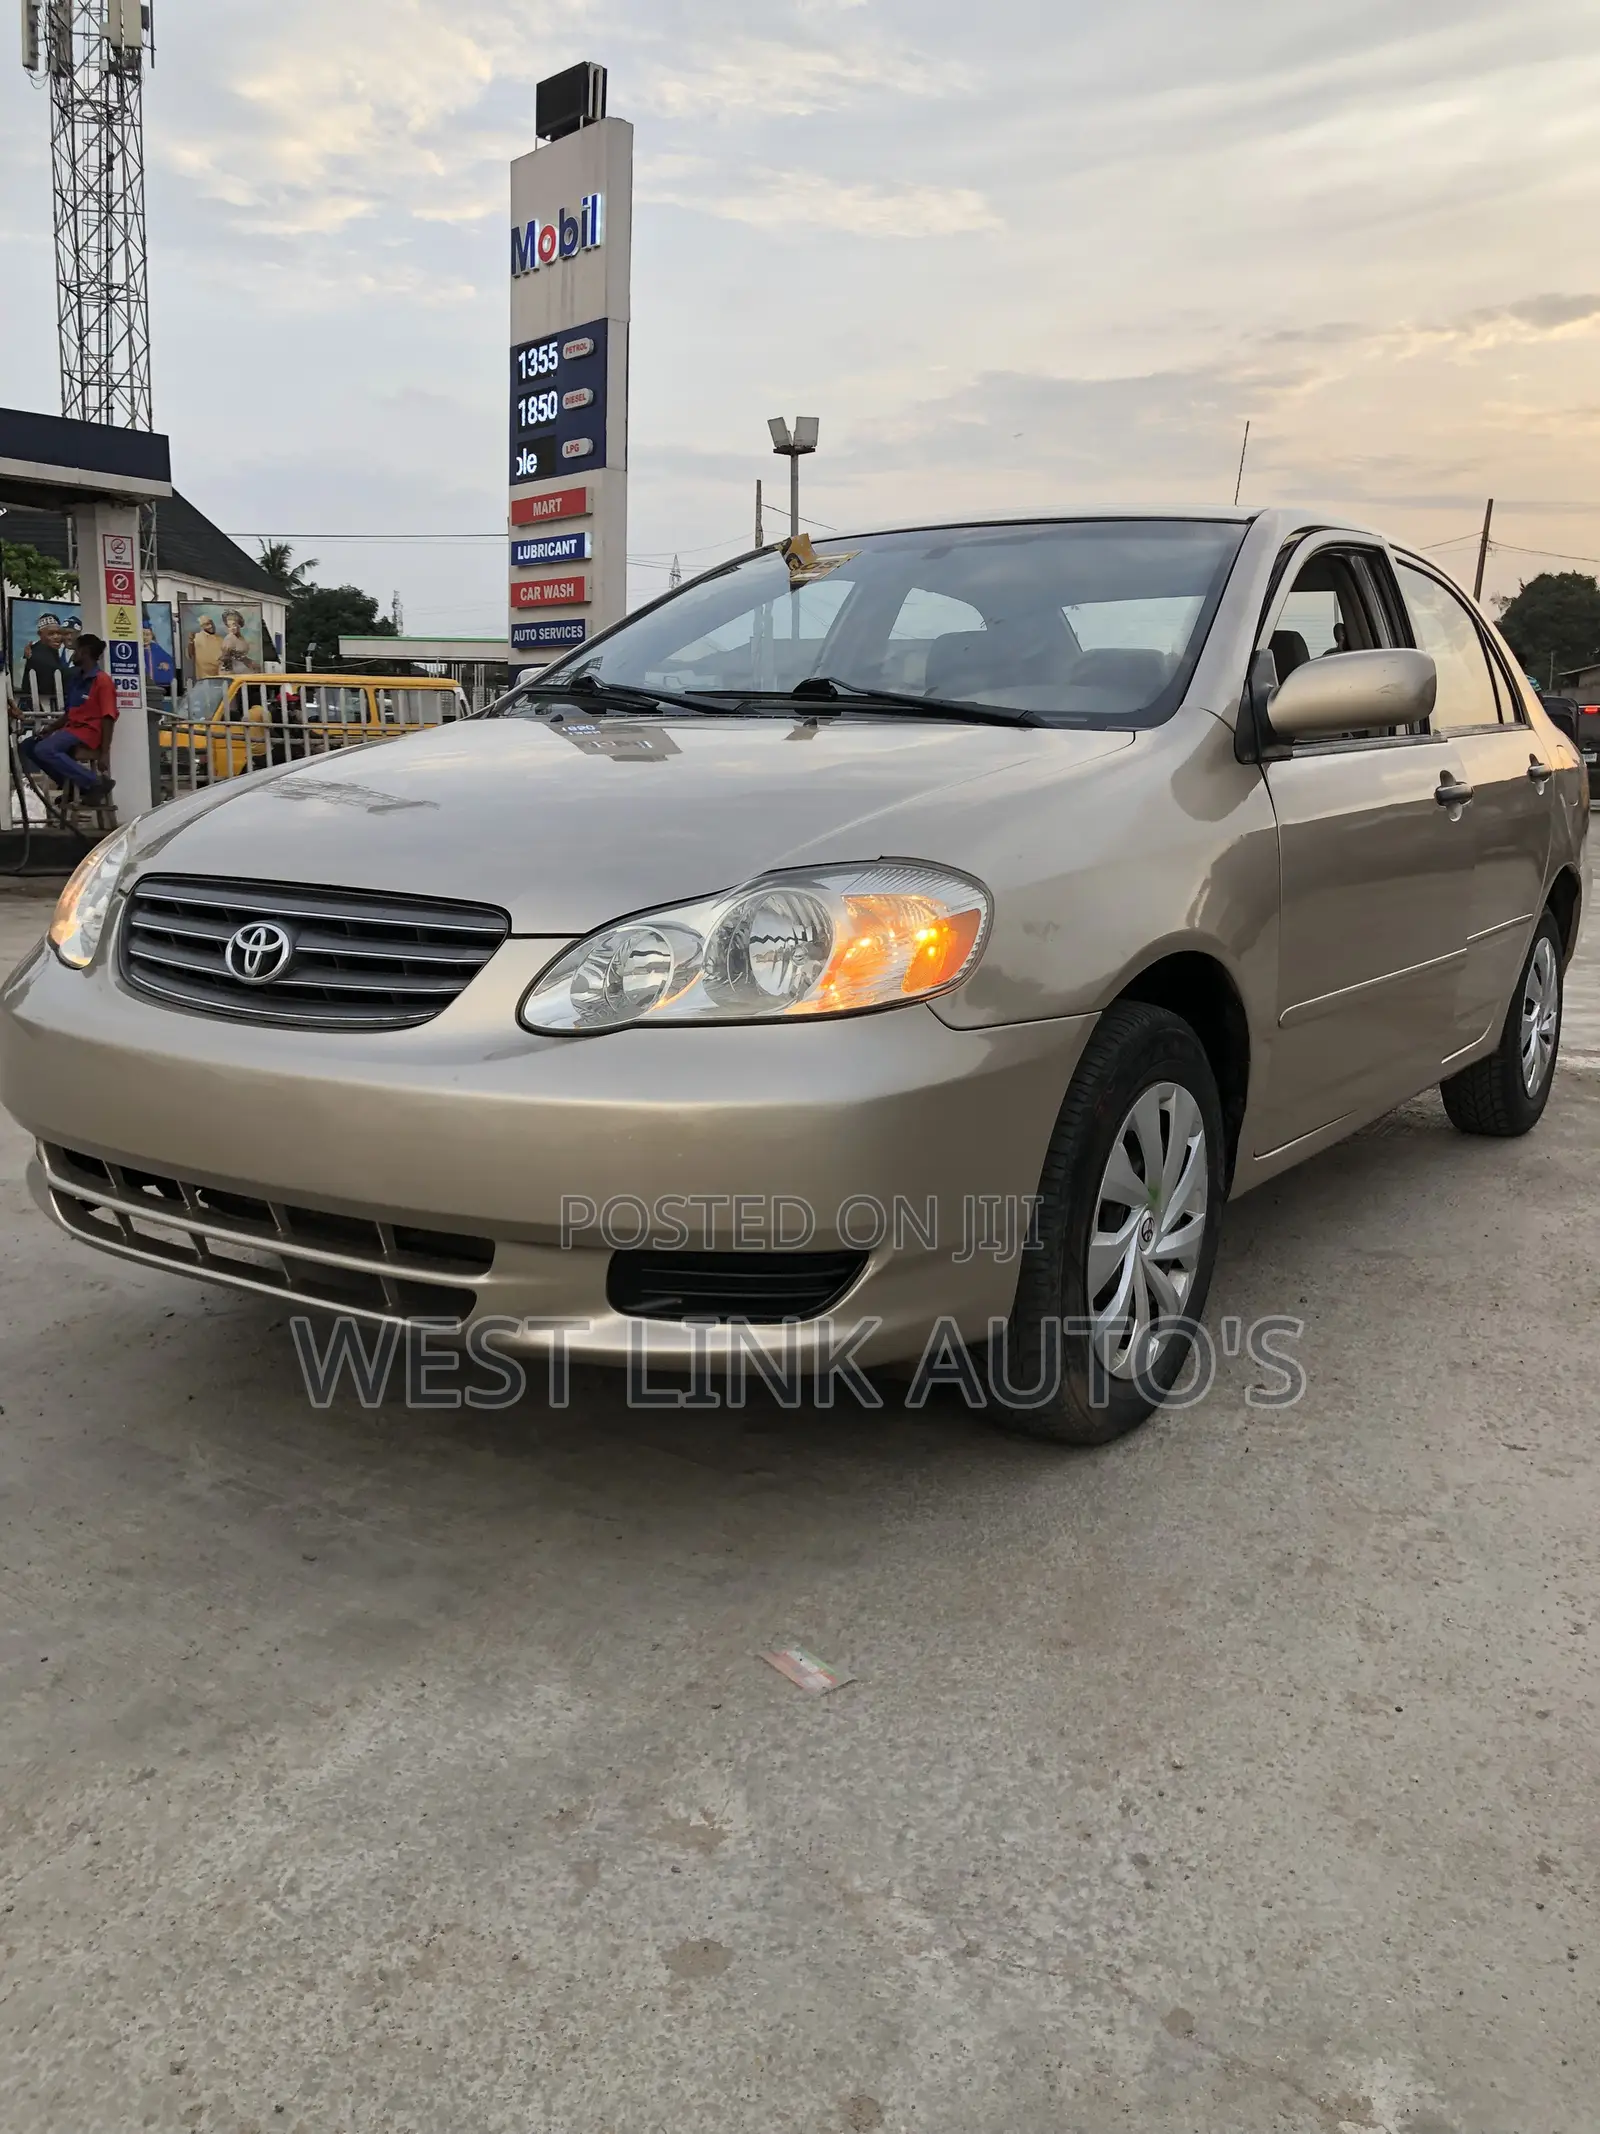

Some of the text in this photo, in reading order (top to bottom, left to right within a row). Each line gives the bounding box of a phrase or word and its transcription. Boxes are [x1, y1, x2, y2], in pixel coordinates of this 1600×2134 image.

[511, 193, 601, 276] Mobil
[565, 342, 588, 355] PETROL
[518, 341, 559, 379] 1355
[518, 390, 558, 427] 1850
[565, 394, 587, 405] DIESEL
[565, 443, 580, 454] LPG
[533, 498, 562, 516] MART
[517, 539, 577, 560] LUBRICANT
[520, 583, 575, 601] CAR WASH
[513, 625, 584, 642] AUTO SERVICES
[114, 678, 138, 690] POS
